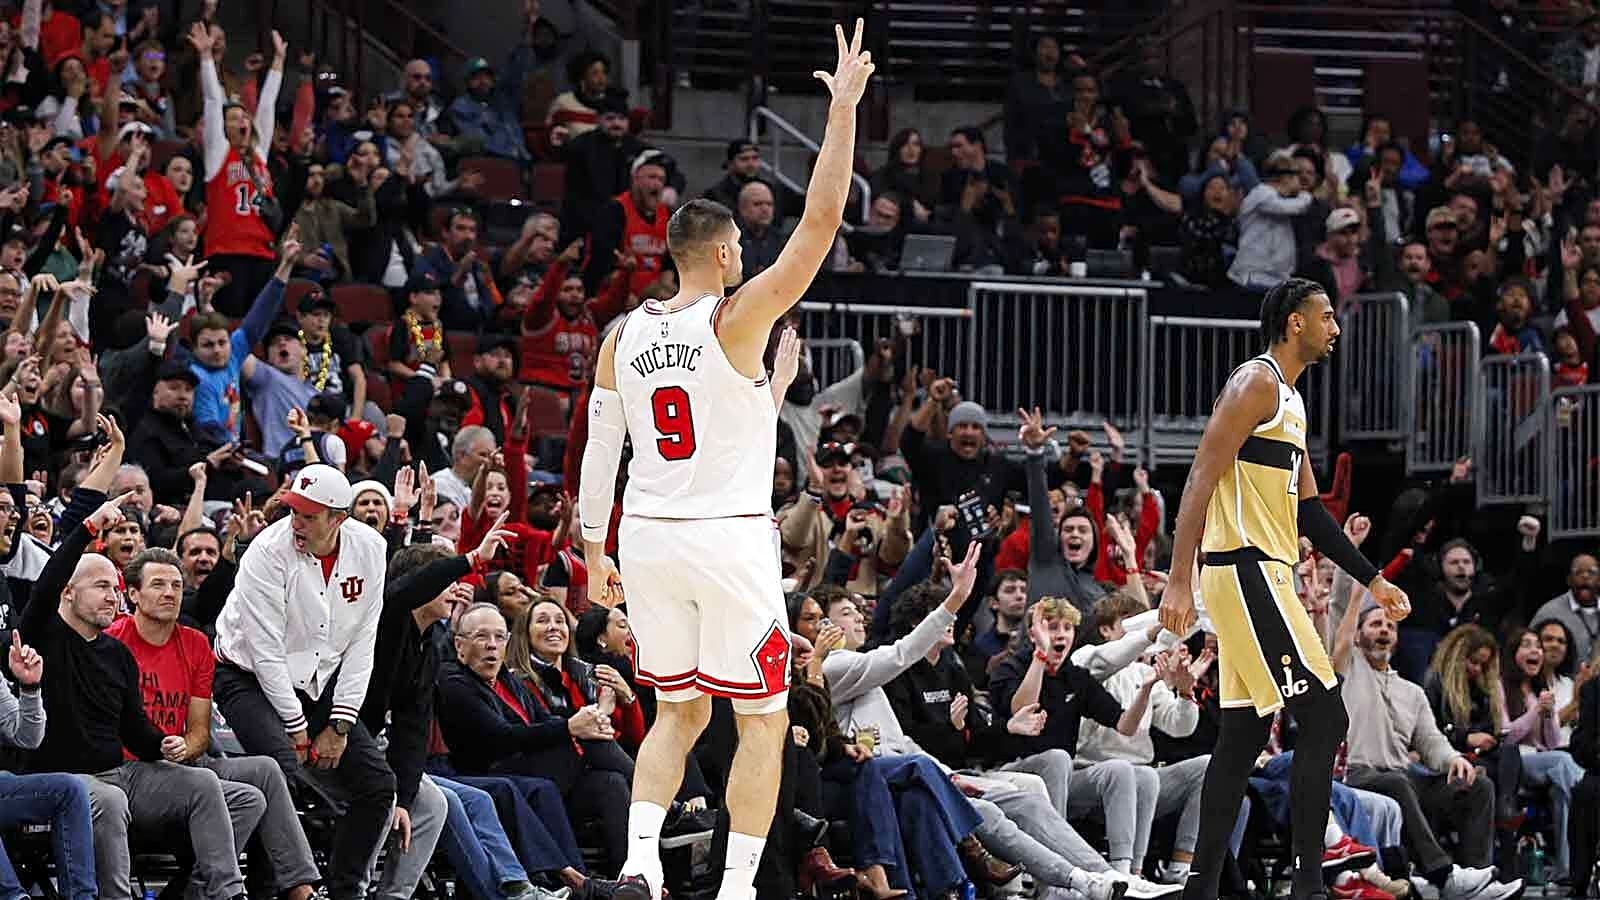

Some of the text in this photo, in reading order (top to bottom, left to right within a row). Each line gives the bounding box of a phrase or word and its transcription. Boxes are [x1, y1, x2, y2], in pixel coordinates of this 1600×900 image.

[630, 342, 703, 378] VUČEVIĆ
[651, 385, 697, 462] 9
[142, 672, 159, 689] HI
